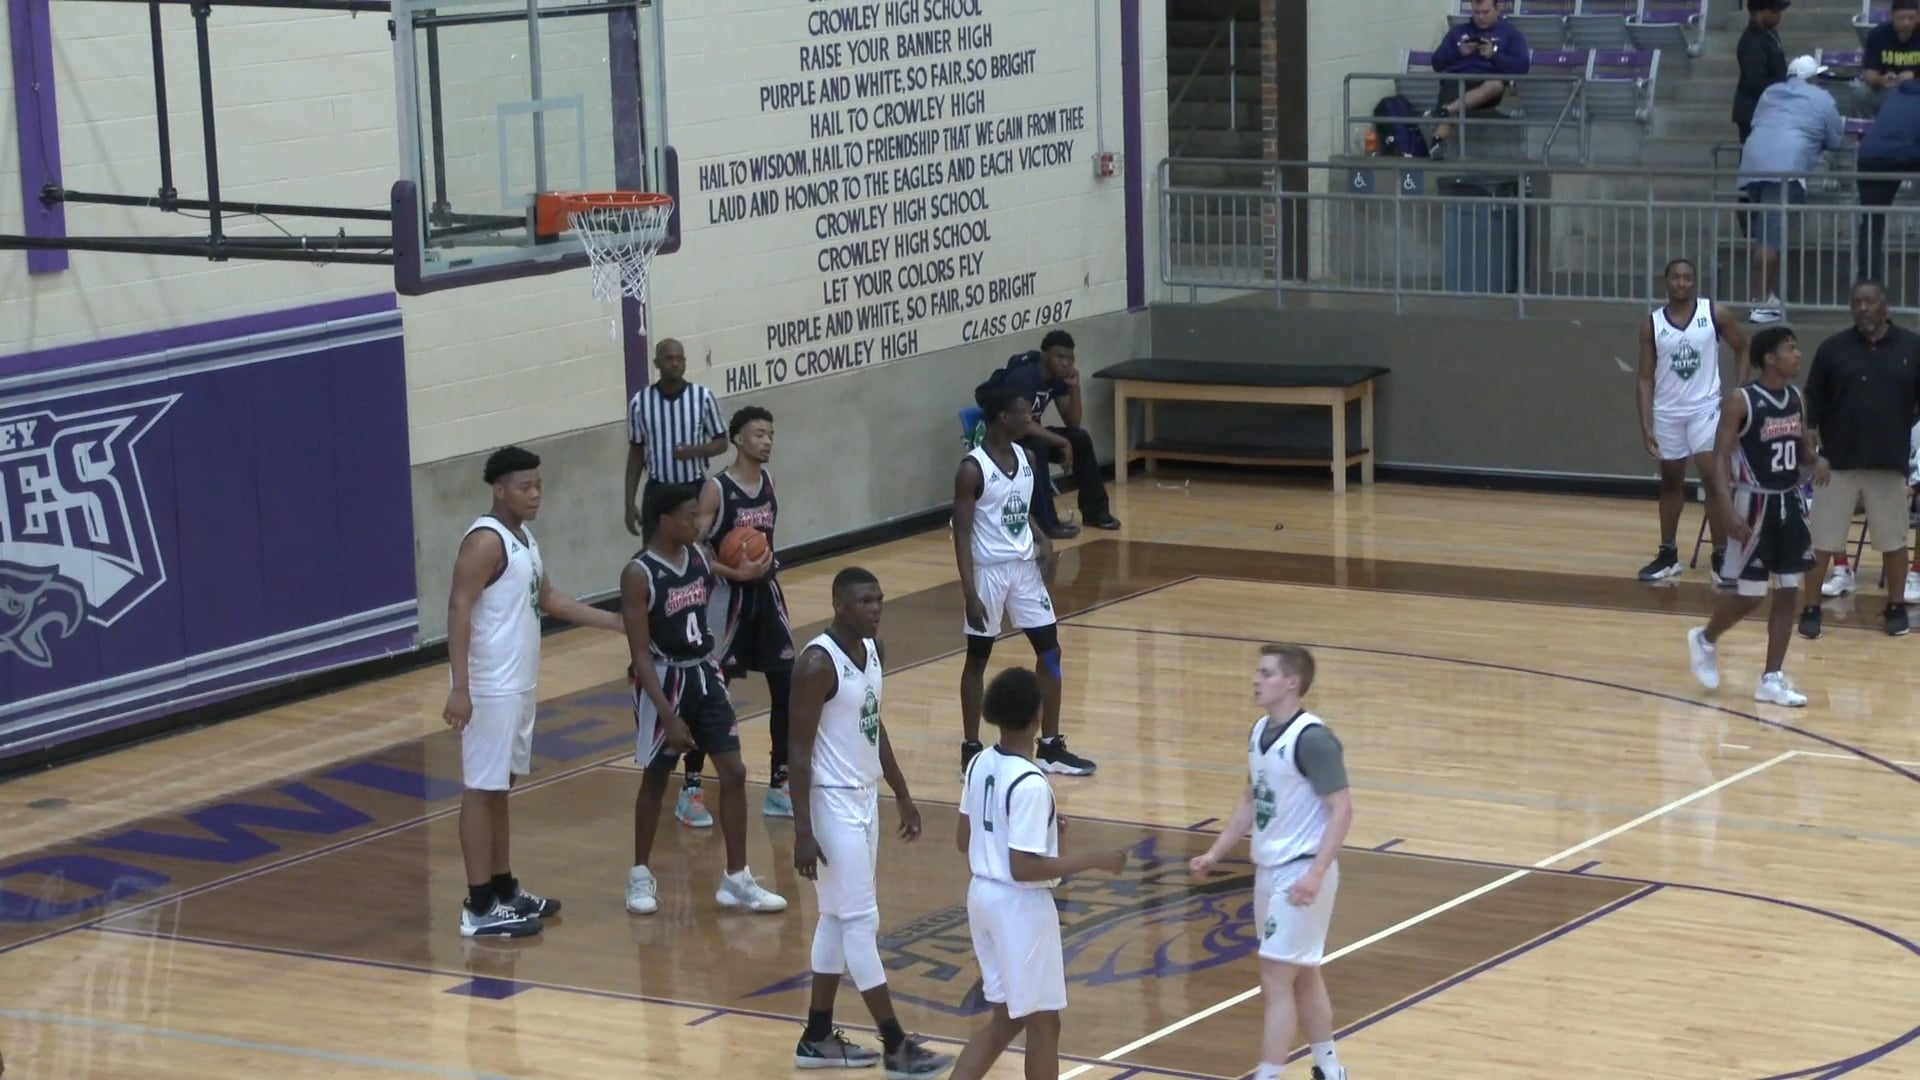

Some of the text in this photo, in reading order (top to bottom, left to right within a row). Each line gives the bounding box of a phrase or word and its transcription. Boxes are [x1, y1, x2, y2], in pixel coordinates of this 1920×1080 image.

[808, 0, 981, 35] CROWLEY HIGH SCHOOL
[800, 23, 991, 71] RAISE YOUR BANNER HIGH
[760, 80, 815, 111] PURPLE
[819, 76, 849, 103] AND
[991, 49, 1035, 78] BRIGHT
[811, 89, 984, 138] HAIL TO CROWLEY HIGH
[699, 163, 728, 190] HAIL
[729, 160, 746, 185] TO
[812, 144, 843, 172] HAIL
[843, 141, 862, 167] TO
[867, 129, 939, 164] FRIENDSHIP
[943, 124, 970, 151] THAT
[975, 121, 993, 145] WE
[996, 116, 1022, 142] GAIN
[1027, 111, 1055, 137] FROM
[1059, 106, 1083, 131] THEE
[709, 139, 1073, 223] LAUD AND HONOR TO THE EAGLES AND EACH VICTORY
[816, 187, 988, 238] CROWLEY HIGH SCHOOL
[818, 219, 990, 271] CROWLEY HIGH SCHOOL
[824, 251, 982, 304] LET YOUR COLORS FLY
[767, 316, 820, 349] PURPLE
[826, 310, 852, 337] AND
[989, 272, 1036, 303] BRIGHT
[962, 299, 1073, 343] CLASS OF 1987
[726, 329, 916, 392] HAIL TO CROWLEY HIGH
[1771, 439, 1797, 473] 20
[686, 611, 703, 646] 4
[983, 774, 995, 833] 0
